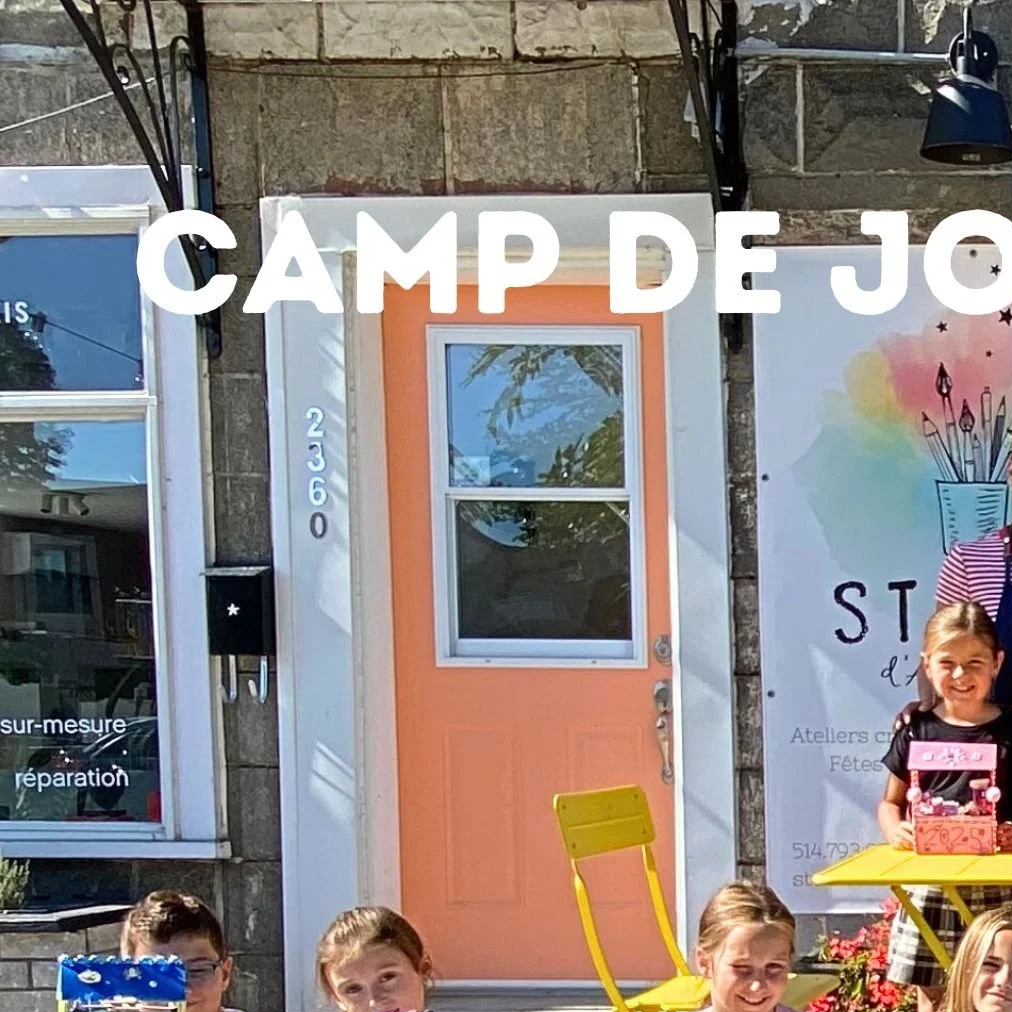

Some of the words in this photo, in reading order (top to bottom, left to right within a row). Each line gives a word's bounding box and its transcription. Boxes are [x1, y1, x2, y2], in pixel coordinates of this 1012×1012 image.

[0, 301, 29, 323] IS
[306, 406, 328, 539] 2360
[833, 580, 917, 645] ST
[0, 718, 127, 734] sur-mesure
[790, 727, 869, 744] Ateliers
[829, 755, 884, 772] Fêtes
[15, 767, 129, 792] réparation
